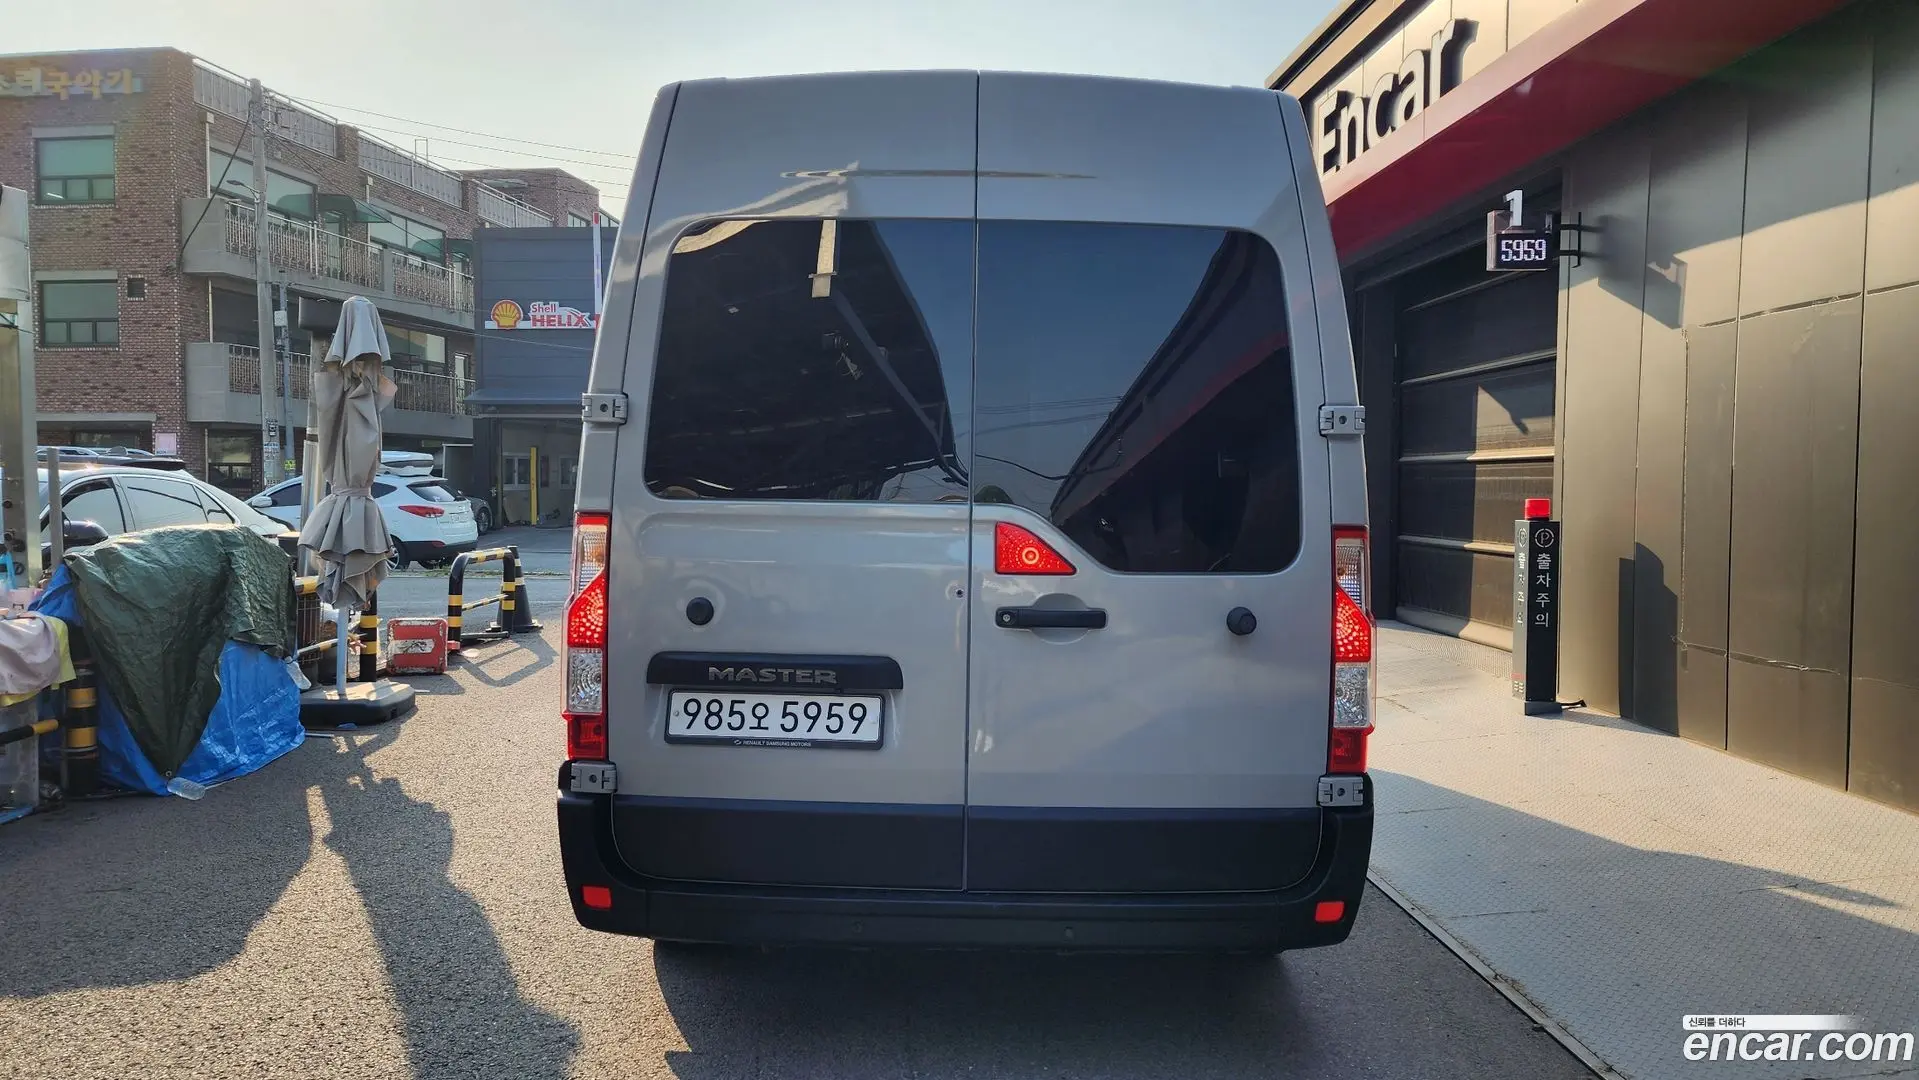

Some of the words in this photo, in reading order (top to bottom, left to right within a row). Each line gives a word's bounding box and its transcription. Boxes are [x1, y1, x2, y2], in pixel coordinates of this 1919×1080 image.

[1317, 18, 1464, 176] Encar
[1503, 189, 1523, 227] 1
[1501, 239, 1547, 261] 5959
[531, 303, 557, 313] Shell
[531, 314, 589, 328] HELIX
[1535, 552, 1552, 628] 출차주의
[708, 666, 838, 684] MASTER
[683, 698, 770, 731] 985오
[780, 701, 868, 734] 5959
